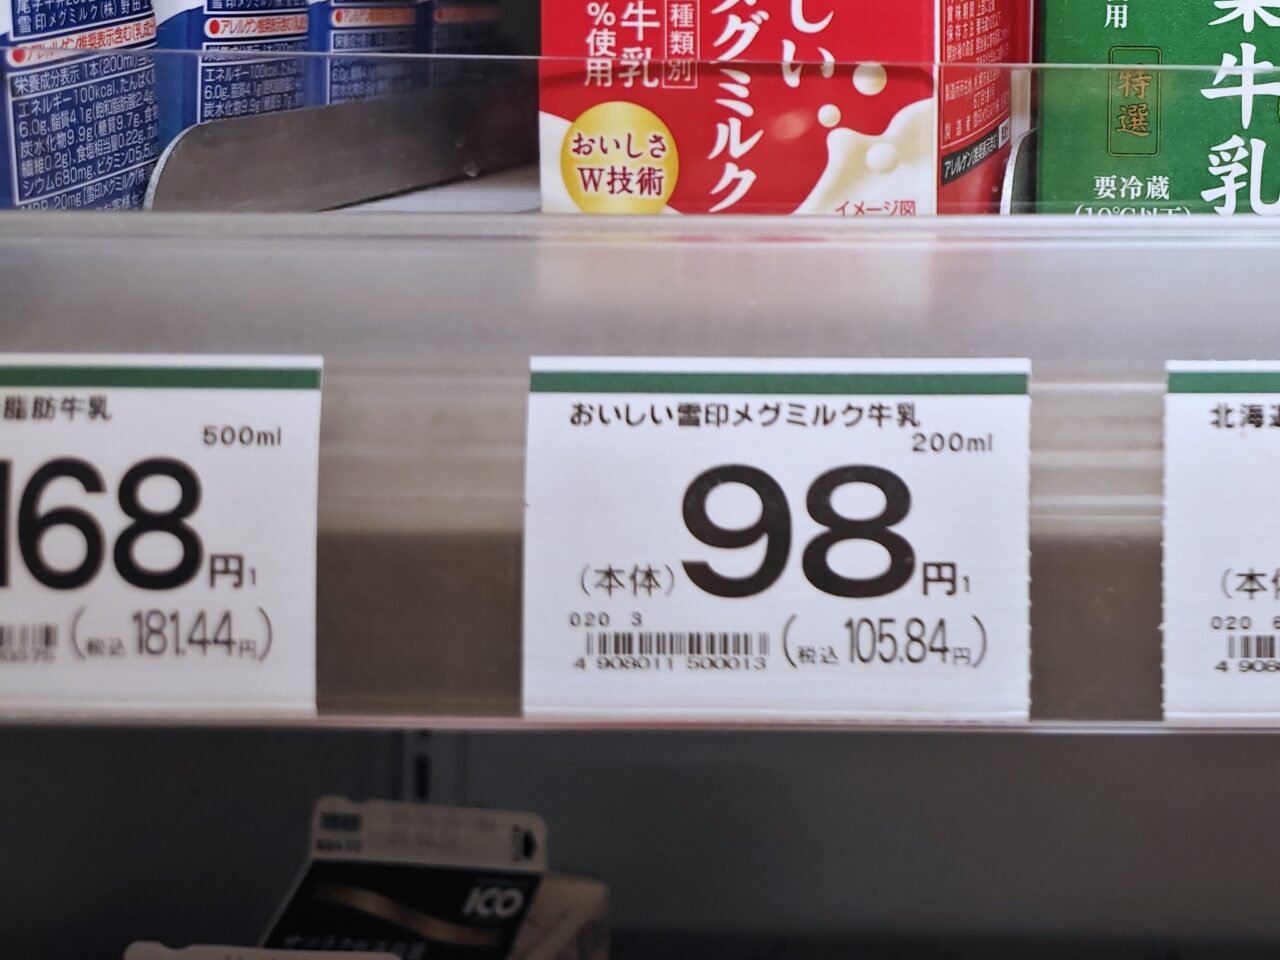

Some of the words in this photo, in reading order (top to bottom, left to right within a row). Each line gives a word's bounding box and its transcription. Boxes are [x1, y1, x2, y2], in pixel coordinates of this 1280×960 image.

[619, 0, 661, 89] 牛乳
[668, 3, 696, 82] 種類別
[1115, 67, 1152, 138] 特選
[571, 131, 667, 159] おいしさ
[577, 167, 665, 196] W技術
[1093, 174, 1171, 201] 要冷蔵
[835, 200, 915, 217] イメージ図
[1, 395, 112, 421] 脂肪牛乳
[569, 402, 921, 427] おいしい雪印メグミルク牛乳
[202, 426, 282, 446] 500ml
[911, 433, 994, 453] 200ml
[579, 563, 676, 598] (本体)
[569, 612, 612, 627] 020
[1211, 616, 1252, 630] 020
